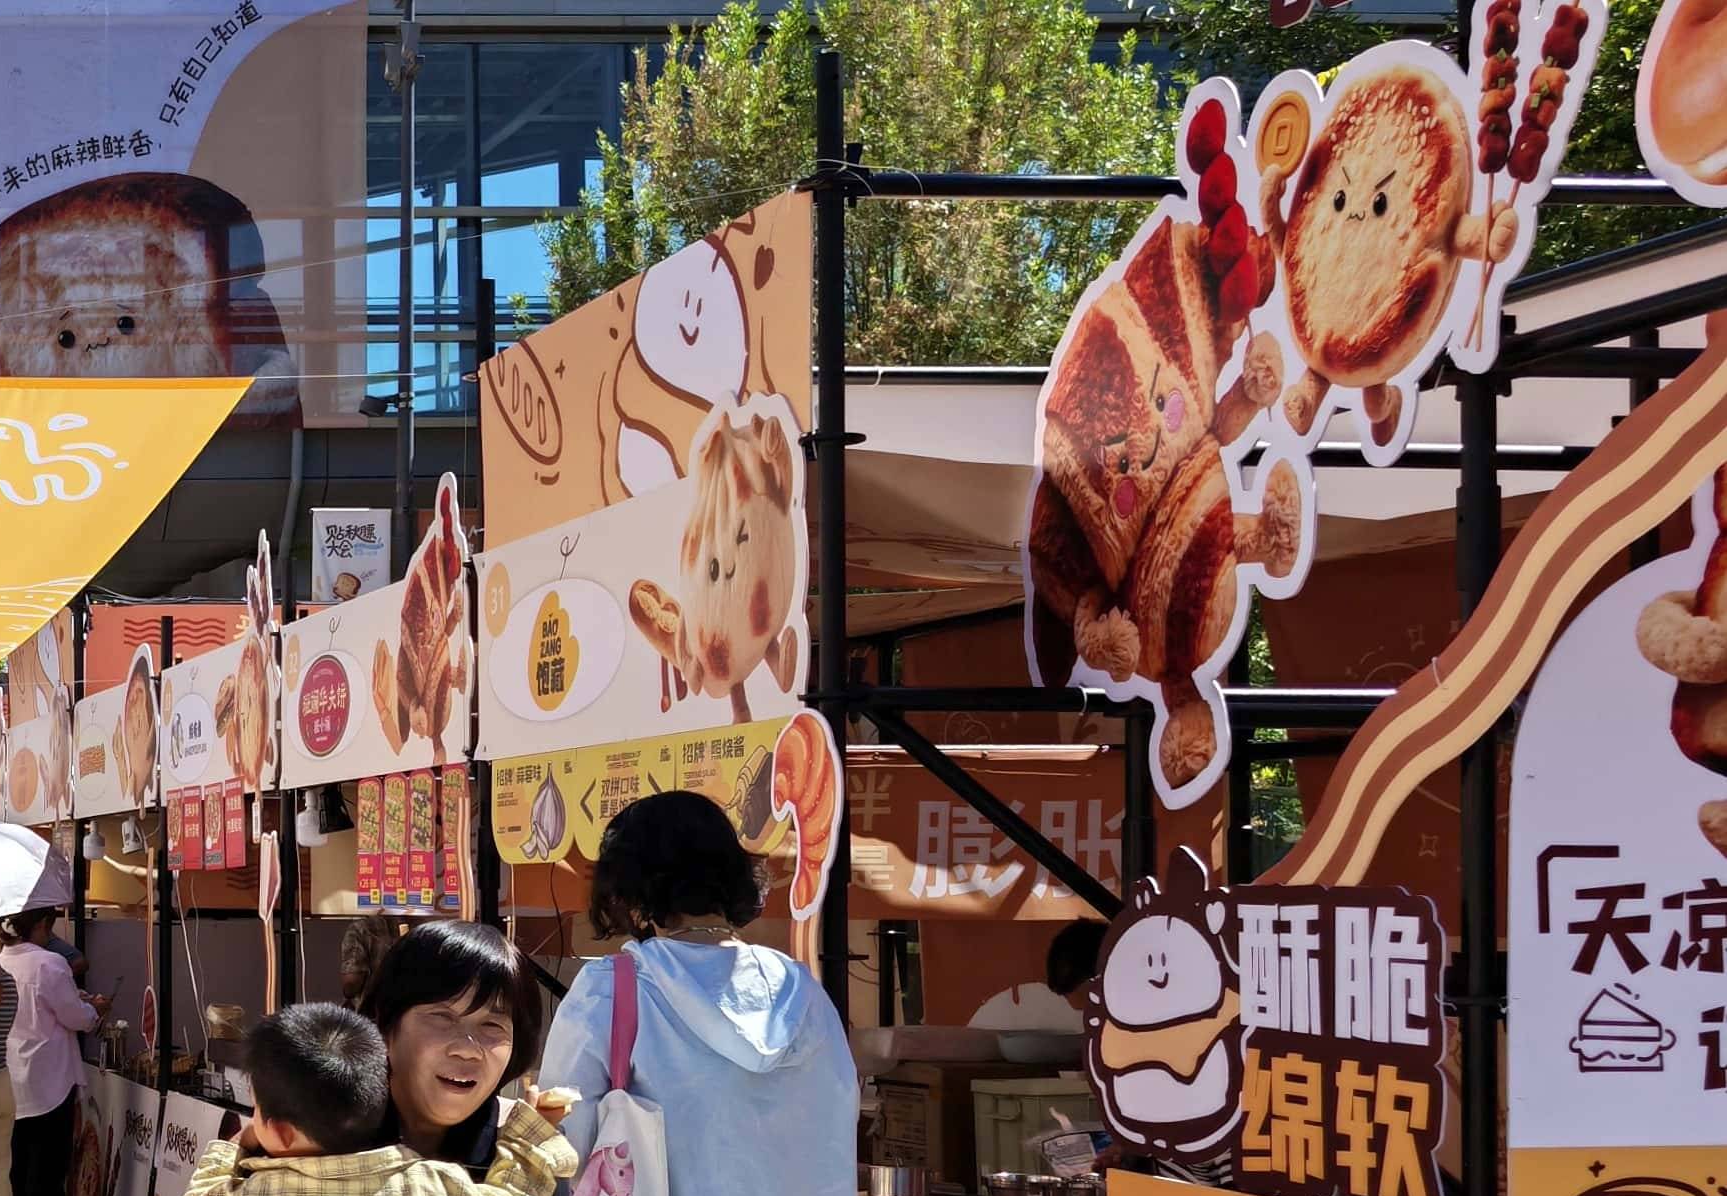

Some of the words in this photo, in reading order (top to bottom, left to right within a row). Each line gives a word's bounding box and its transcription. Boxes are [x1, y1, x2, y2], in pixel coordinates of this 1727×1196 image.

[325, 540, 354, 558] 大会
[489, 585, 505, 615] 31
[600, 774, 640, 798] 双拼口味
[1567, 880, 1727, 976] 天凉
[1236, 902, 1429, 1047] 酥脆
